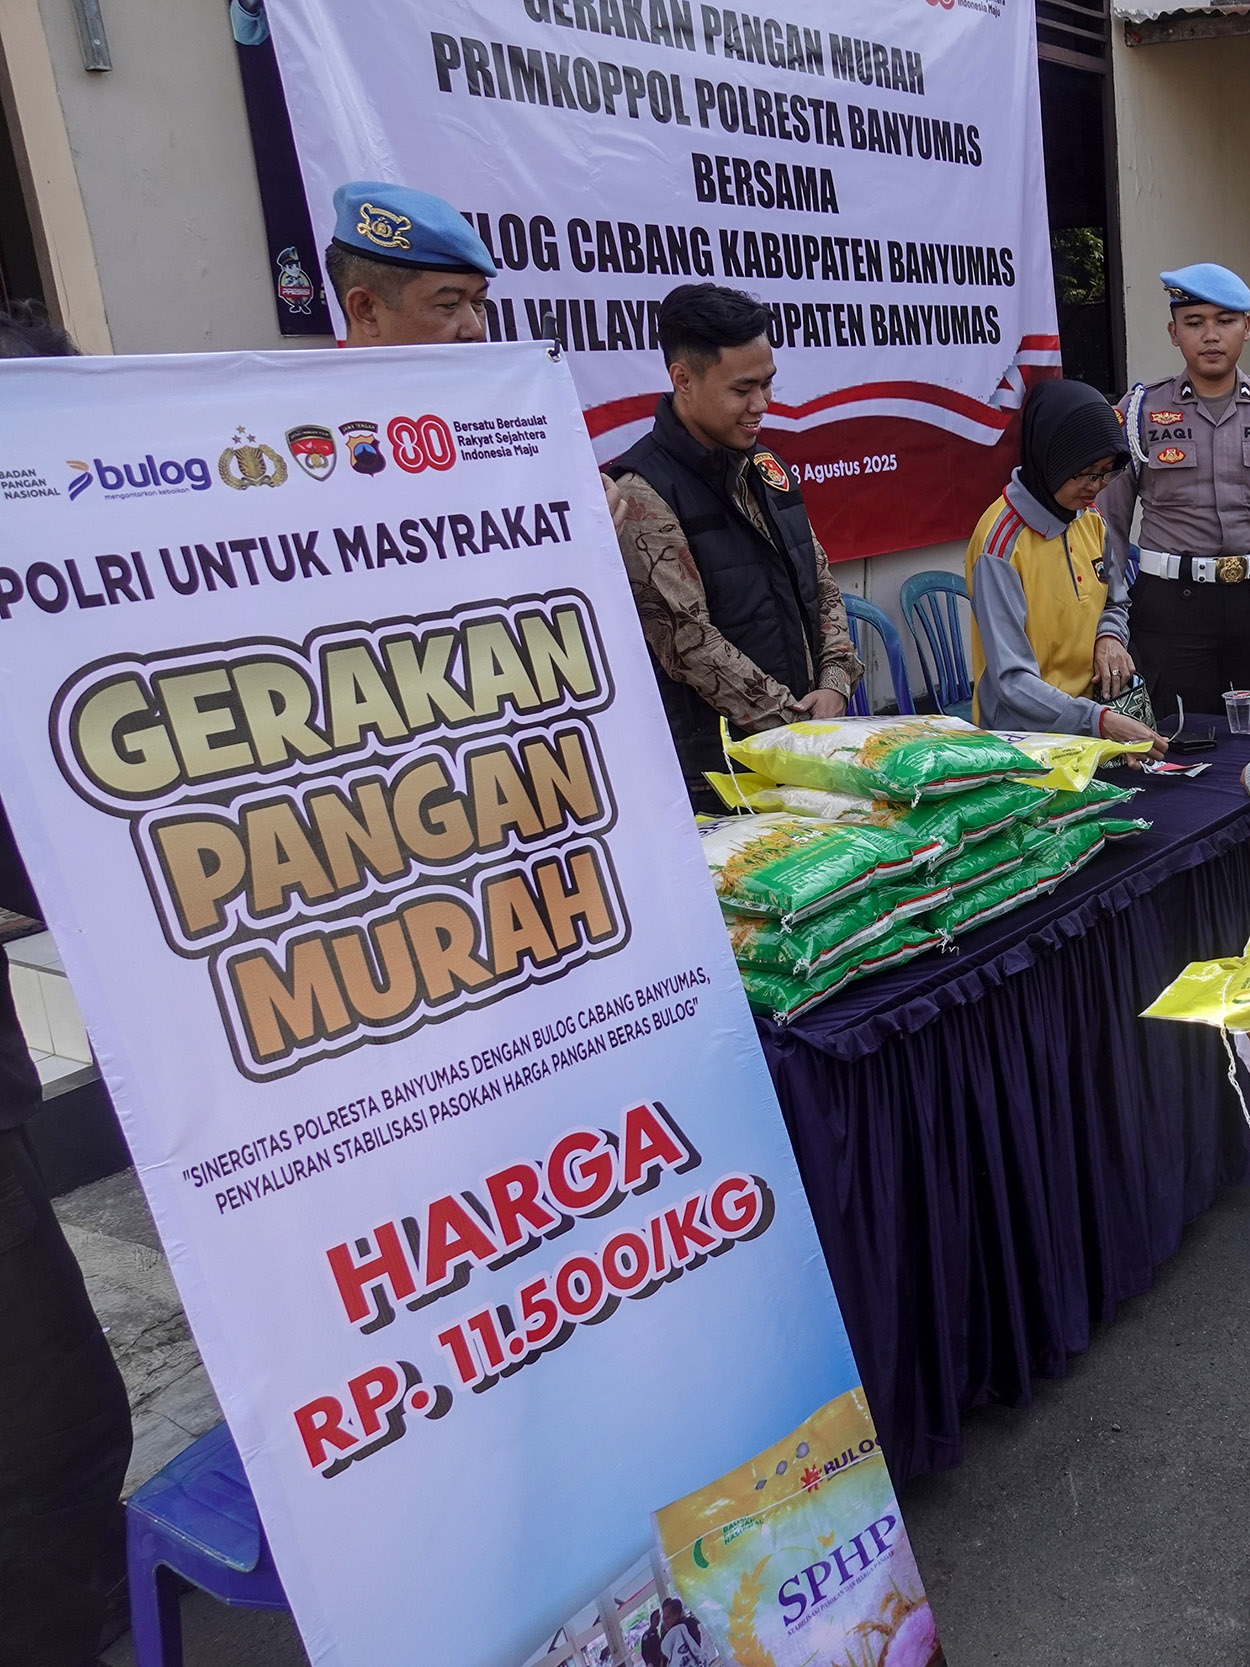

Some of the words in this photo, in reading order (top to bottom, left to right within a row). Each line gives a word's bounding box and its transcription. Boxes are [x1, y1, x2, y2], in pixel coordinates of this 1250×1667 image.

[702, 5, 825, 76] PANGAN
[829, 33, 926, 95] MURAH
[431, 32, 692, 126] PRIMKOPPOL
[695, 78, 845, 147] POLRESTA
[848, 104, 983, 166] BANYUMAS
[691, 153, 839, 214] BERSAMA
[460, 211, 561, 271] LOG
[568, 218, 715, 277] CABANG
[719, 229, 884, 282] KABUPATEN
[887, 241, 1015, 287] BANYUMAS
[524, 298, 663, 351] WILAYA
[763, 303, 863, 348] UPATEN
[870, 304, 1001, 347] BANYUMAS
[387, 414, 457, 474] 80
[453, 420, 495, 432] Bersatu
[497, 415, 548, 430] Berdaulat
[457, 434, 494, 447] Rakyat
[495, 430, 546, 445] Sejahtera
[461, 448, 512, 461] Indonesia
[514, 444, 539, 457] Maju
[1148, 428, 1192, 441] ZAQI
[0, 468, 37, 480] BADAN
[1, 478, 48, 490] PANGAN
[4, 487, 62, 501] NASIONAL
[93, 455, 212, 491] bulog
[104, 489, 157, 501] mengantarkan
[158, 486, 191, 497] kebaikan
[804, 459, 860, 484] Agustus
[864, 454, 898, 474] 2025
[0, 551, 156, 619] POLRI
[159, 530, 331, 595] UNTUK
[333, 500, 574, 572] MASYRAKAT
[70, 603, 602, 800] GERAKAN
[152, 729, 604, 939] PANGAN
[228, 849, 617, 1062] MURAH
[182, 1129, 292, 1188] "SINERGITAS
[293, 1095, 380, 1145] POLRESTA
[381, 1060, 470, 1110] BANYUMAS
[470, 1034, 531, 1075] DENGAN
[532, 1015, 576, 1050] BULOG
[577, 993, 635, 1029] CABANG
[635, 966, 711, 1008] BANYUMAS,
[215, 1148, 332, 1215] PENYALURAN
[333, 1108, 428, 1164] STABILISASI
[430, 1078, 502, 1125] PASOKAN
[503, 1058, 551, 1094] HARGA
[551, 1033, 607, 1073] PANGAN
[607, 1017, 652, 1050] BERAS
[653, 996, 699, 1031] BULOG"
[324, 1102, 692, 1328] HARGA
[437, 1175, 765, 1388] 11.500/KG
[778, 1514, 897, 1627] SPHP
